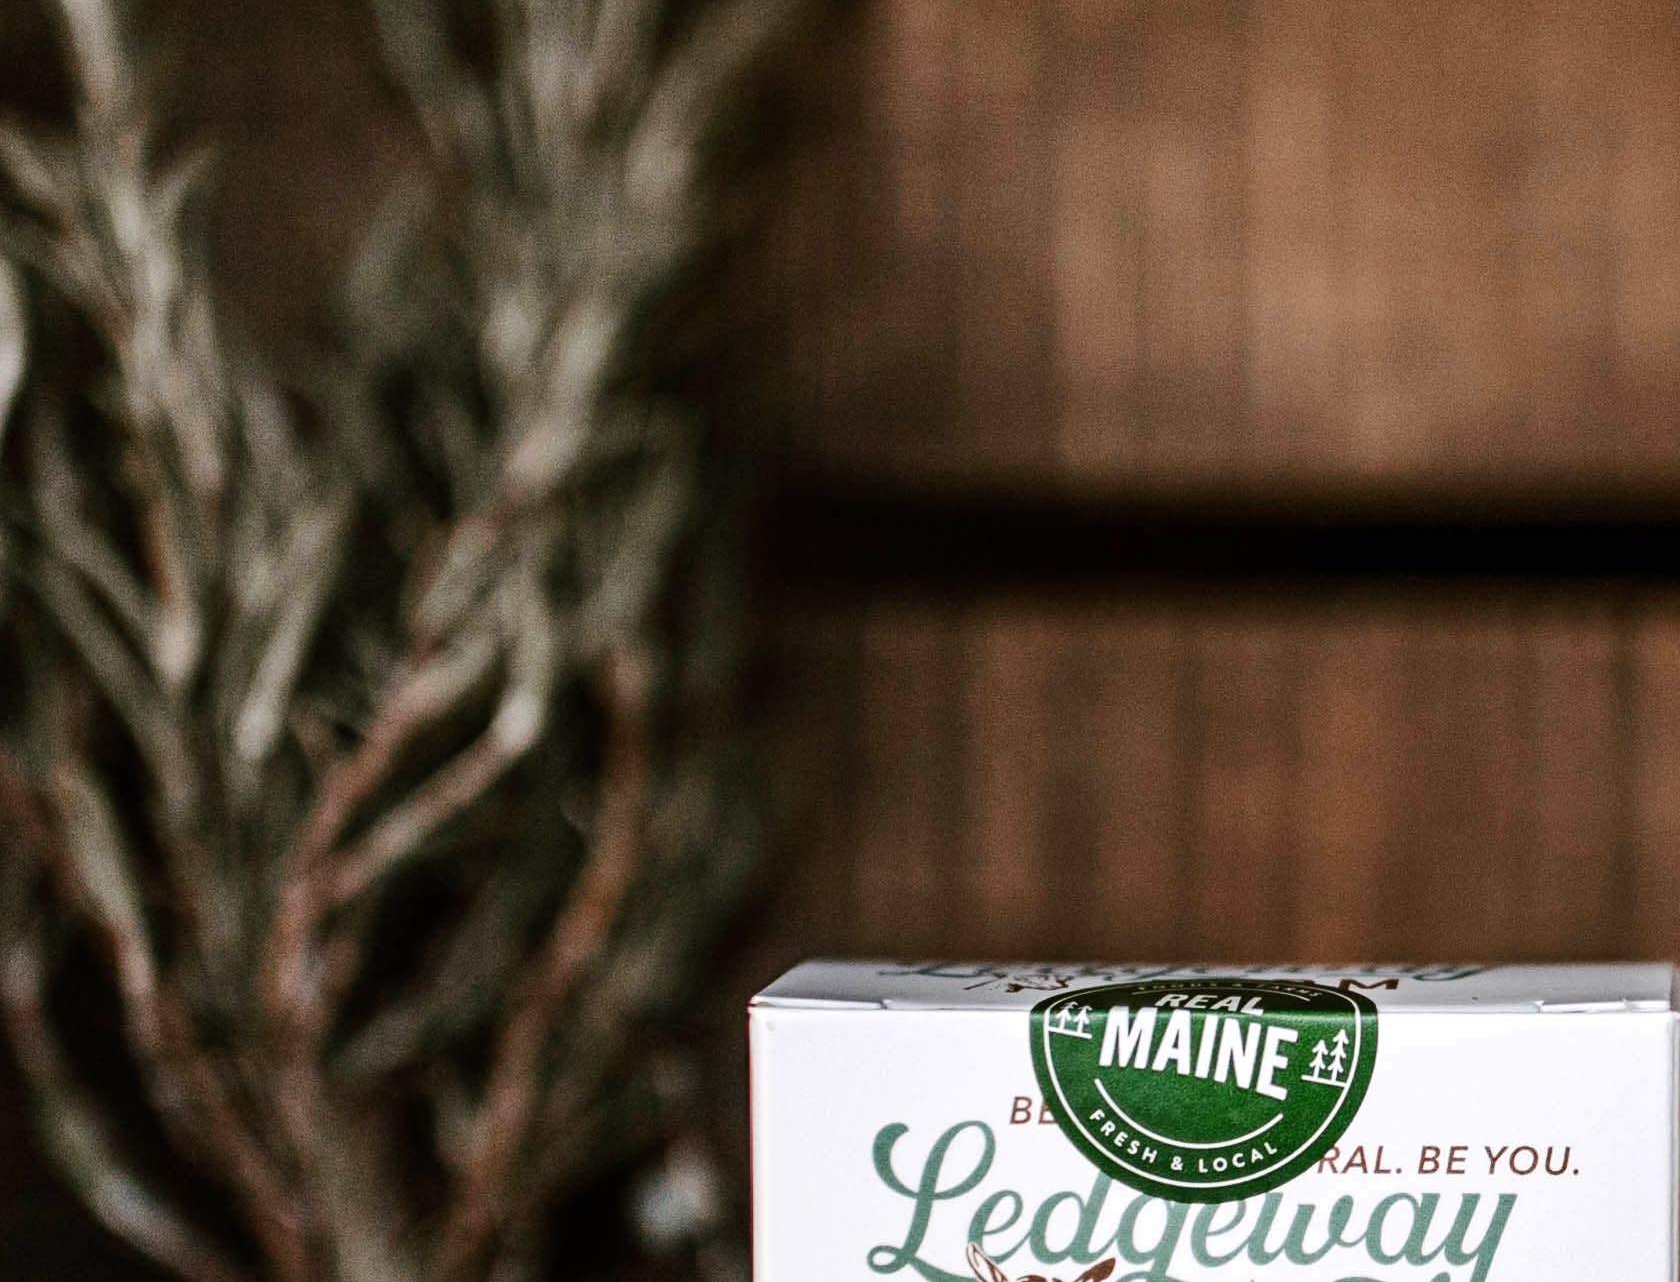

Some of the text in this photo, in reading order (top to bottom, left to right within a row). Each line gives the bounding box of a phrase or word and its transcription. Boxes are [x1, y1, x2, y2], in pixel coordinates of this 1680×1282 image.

[1154, 993, 1265, 1016] REAL
[1098, 1005, 1299, 1101] MAINE
[1089, 1109, 1278, 1173] FRESH & LOCAL
[1317, 1145, 1403, 1174] RAL.
[1417, 1145, 1469, 1174] BE
[1484, 1145, 1580, 1176] YOU.
